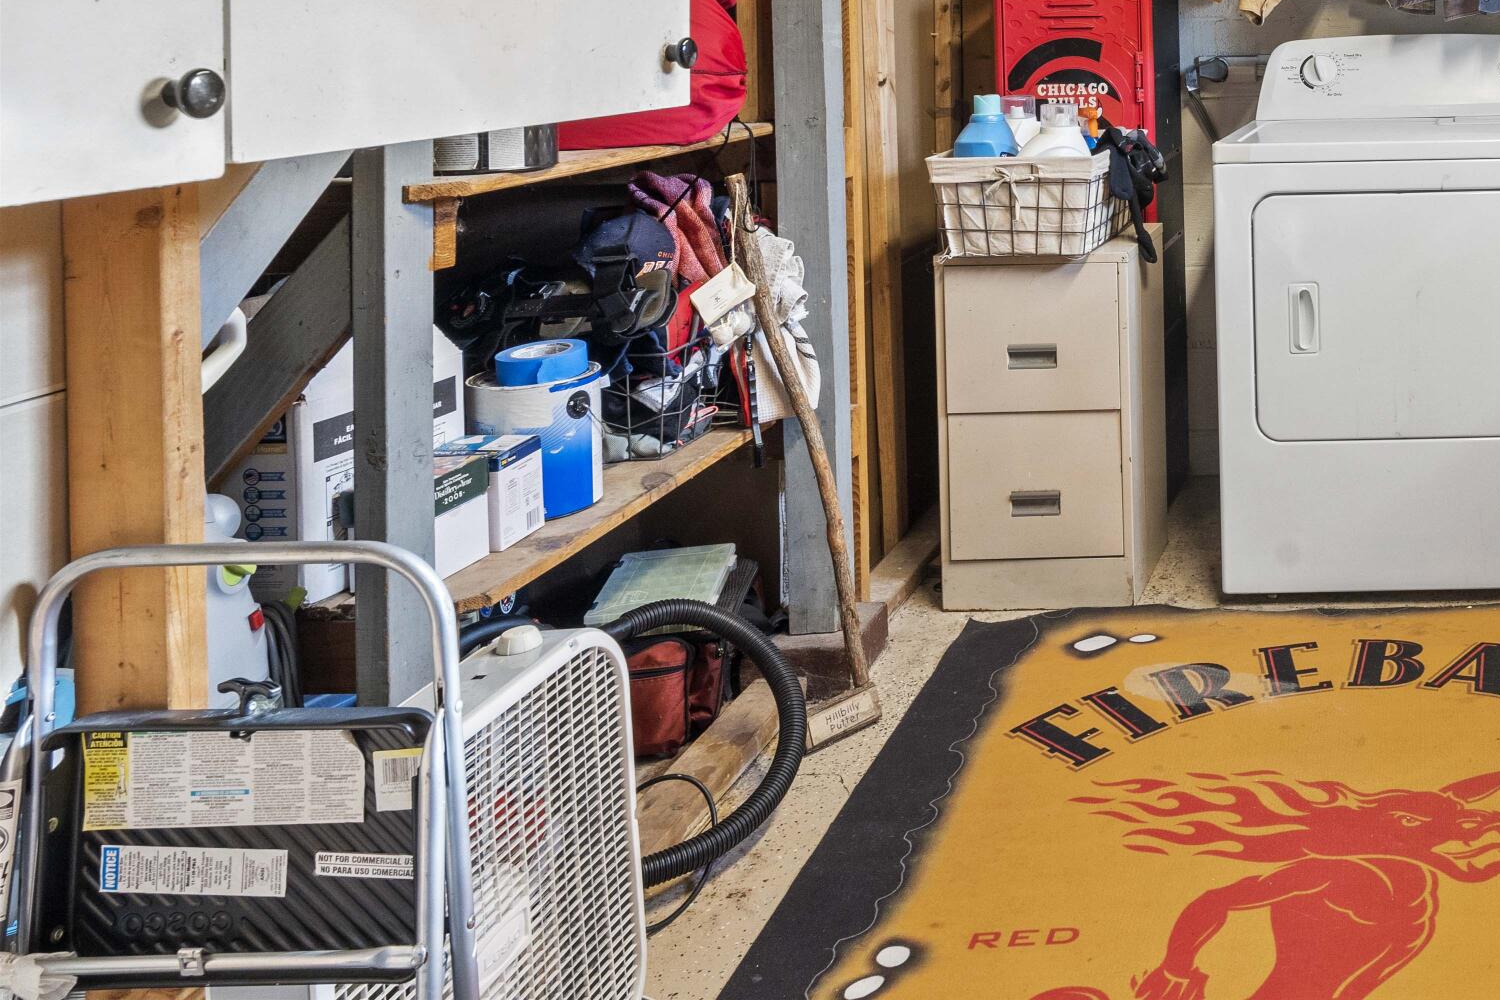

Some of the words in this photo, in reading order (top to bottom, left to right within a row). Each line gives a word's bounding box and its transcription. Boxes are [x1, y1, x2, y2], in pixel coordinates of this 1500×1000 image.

[1037, 83, 1109, 96] CHICAGO
[825, 702, 860, 726] Hillbilly
[830, 713, 860, 733] Putter
[105, 850, 117, 888] NOTICE
[335, 855, 349, 863] FOR
[352, 856, 402, 865] COMMERCIAL
[404, 857, 413, 865] US
[333, 867, 352, 875] PARA
[118, 911, 234, 937] COSCO
[967, 927, 1080, 950] RED
